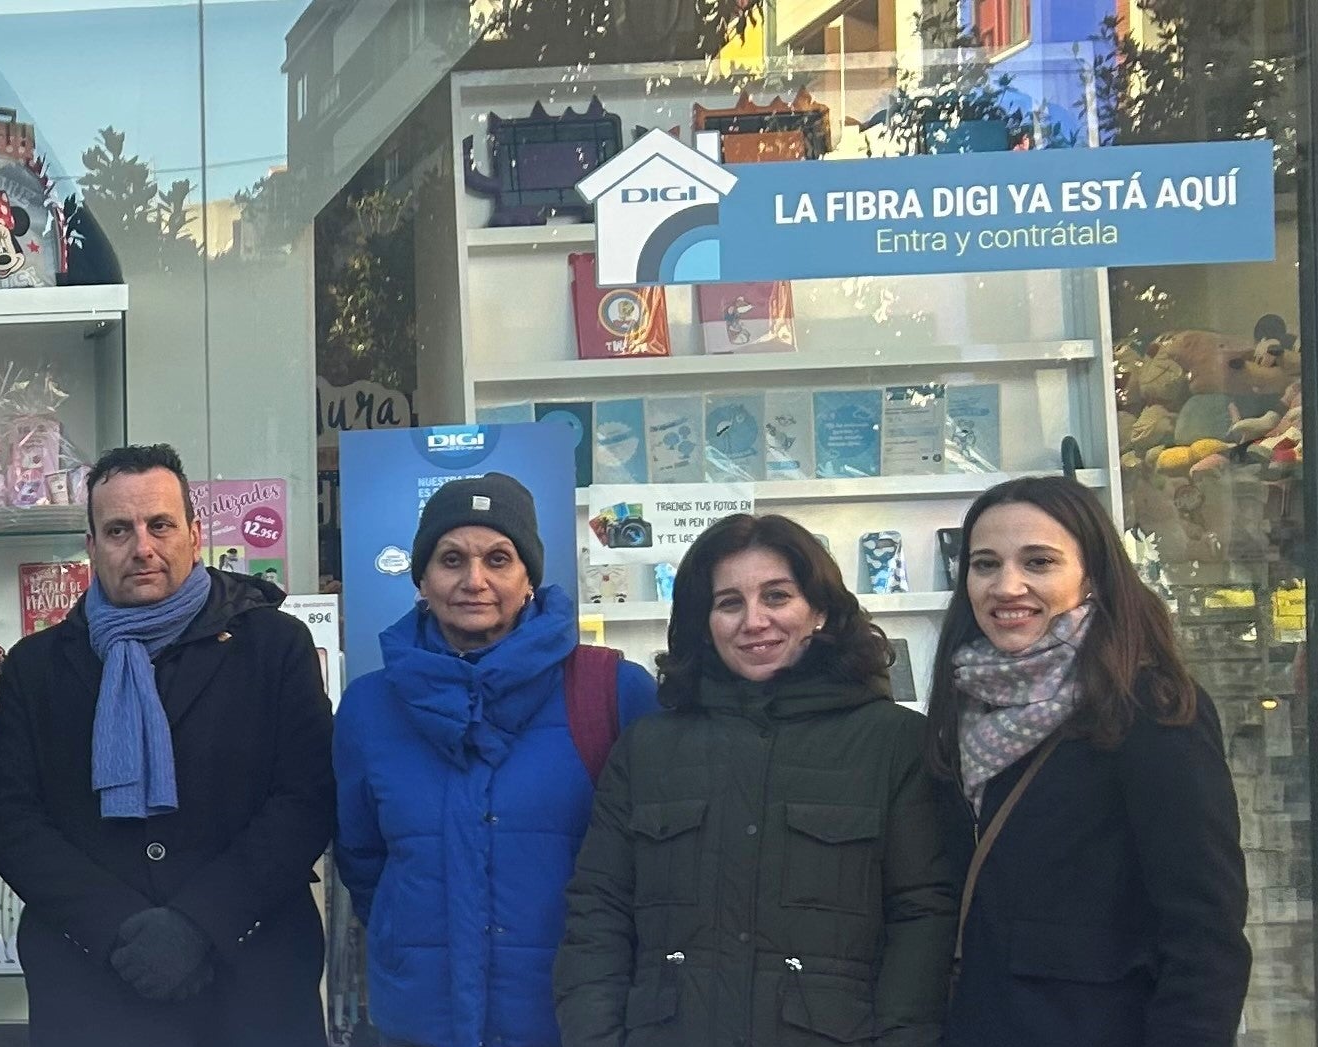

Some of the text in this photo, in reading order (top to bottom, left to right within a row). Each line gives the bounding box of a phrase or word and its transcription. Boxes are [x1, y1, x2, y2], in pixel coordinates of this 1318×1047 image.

[621, 186, 697, 203] DIGI
[774, 168, 1238, 224] LA FIBRA DIGI YA ESTÁ AQUÍ
[877, 220, 1119, 257] Entra y contrátala
[427, 433, 484, 447] DIGI
[308, 613, 332, 624] 89€
